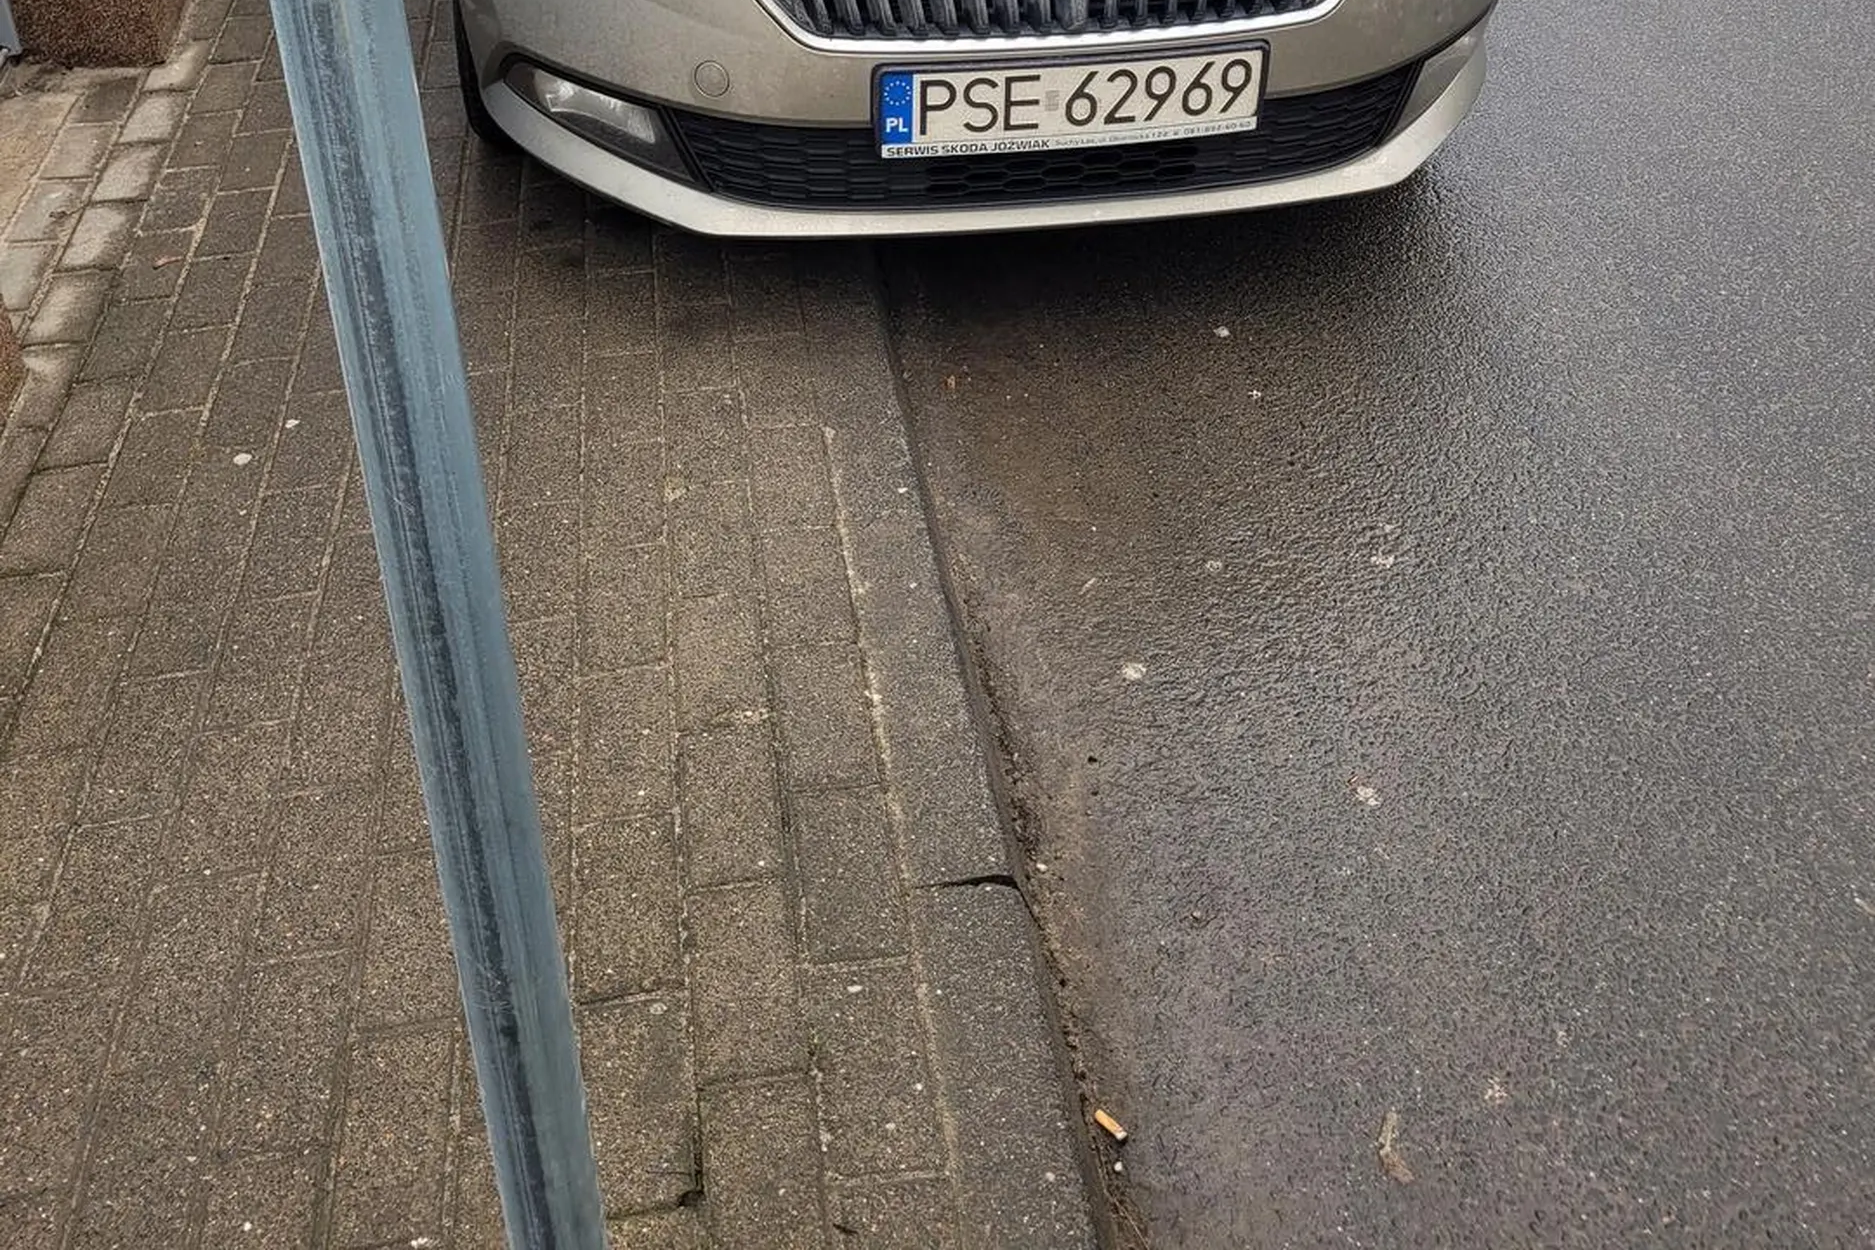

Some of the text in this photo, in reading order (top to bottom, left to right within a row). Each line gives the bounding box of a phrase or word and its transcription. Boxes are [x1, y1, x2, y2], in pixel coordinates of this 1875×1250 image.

[919, 58, 1253, 136] PSE 62969
[885, 116, 909, 133] PL
[886, 144, 939, 157] SERWIS
